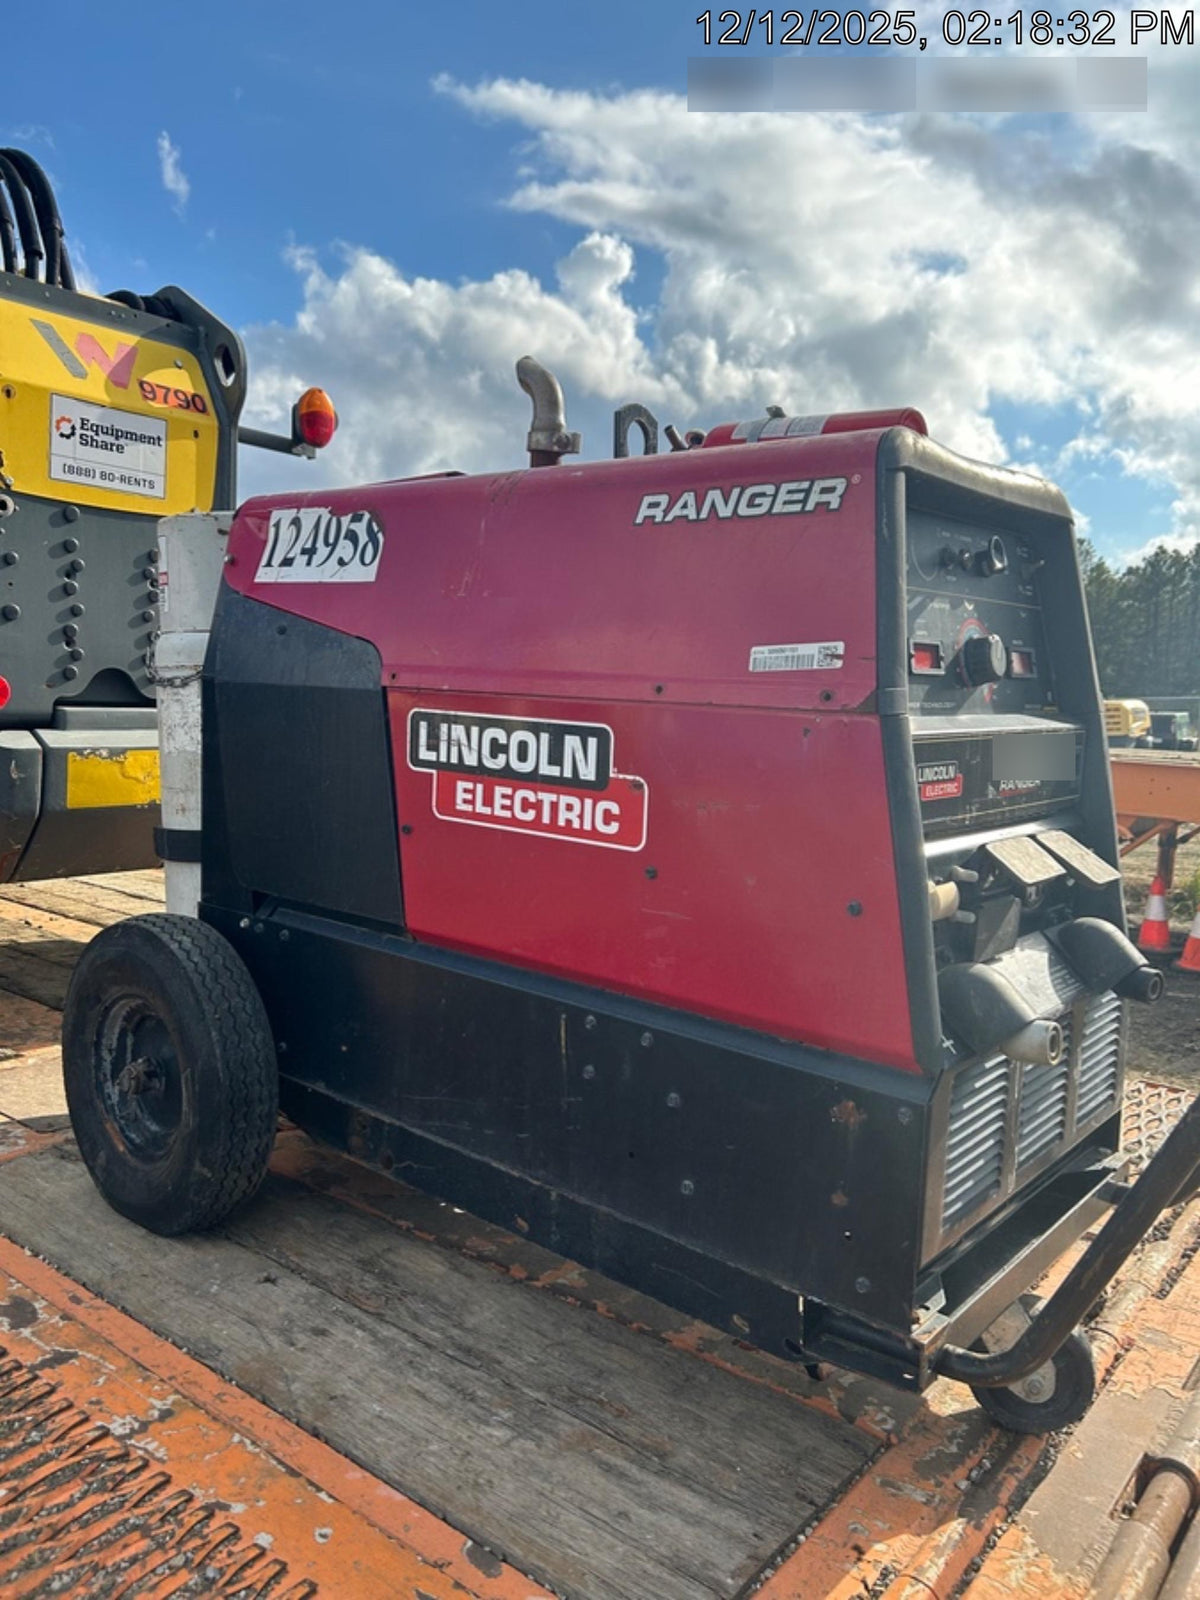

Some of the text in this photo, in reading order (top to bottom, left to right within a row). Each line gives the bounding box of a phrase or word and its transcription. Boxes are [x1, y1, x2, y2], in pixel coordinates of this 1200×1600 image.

[139, 380, 208, 414] 9790
[79, 417, 163, 447] Equipment
[79, 434, 126, 454] Share
[634, 477, 848, 526] RANGER
[261, 512, 382, 568] 124958
[418, 720, 598, 782] LINCOLN
[918, 765, 956, 783] LINCOLN
[455, 780, 620, 836] ELECTRIC
